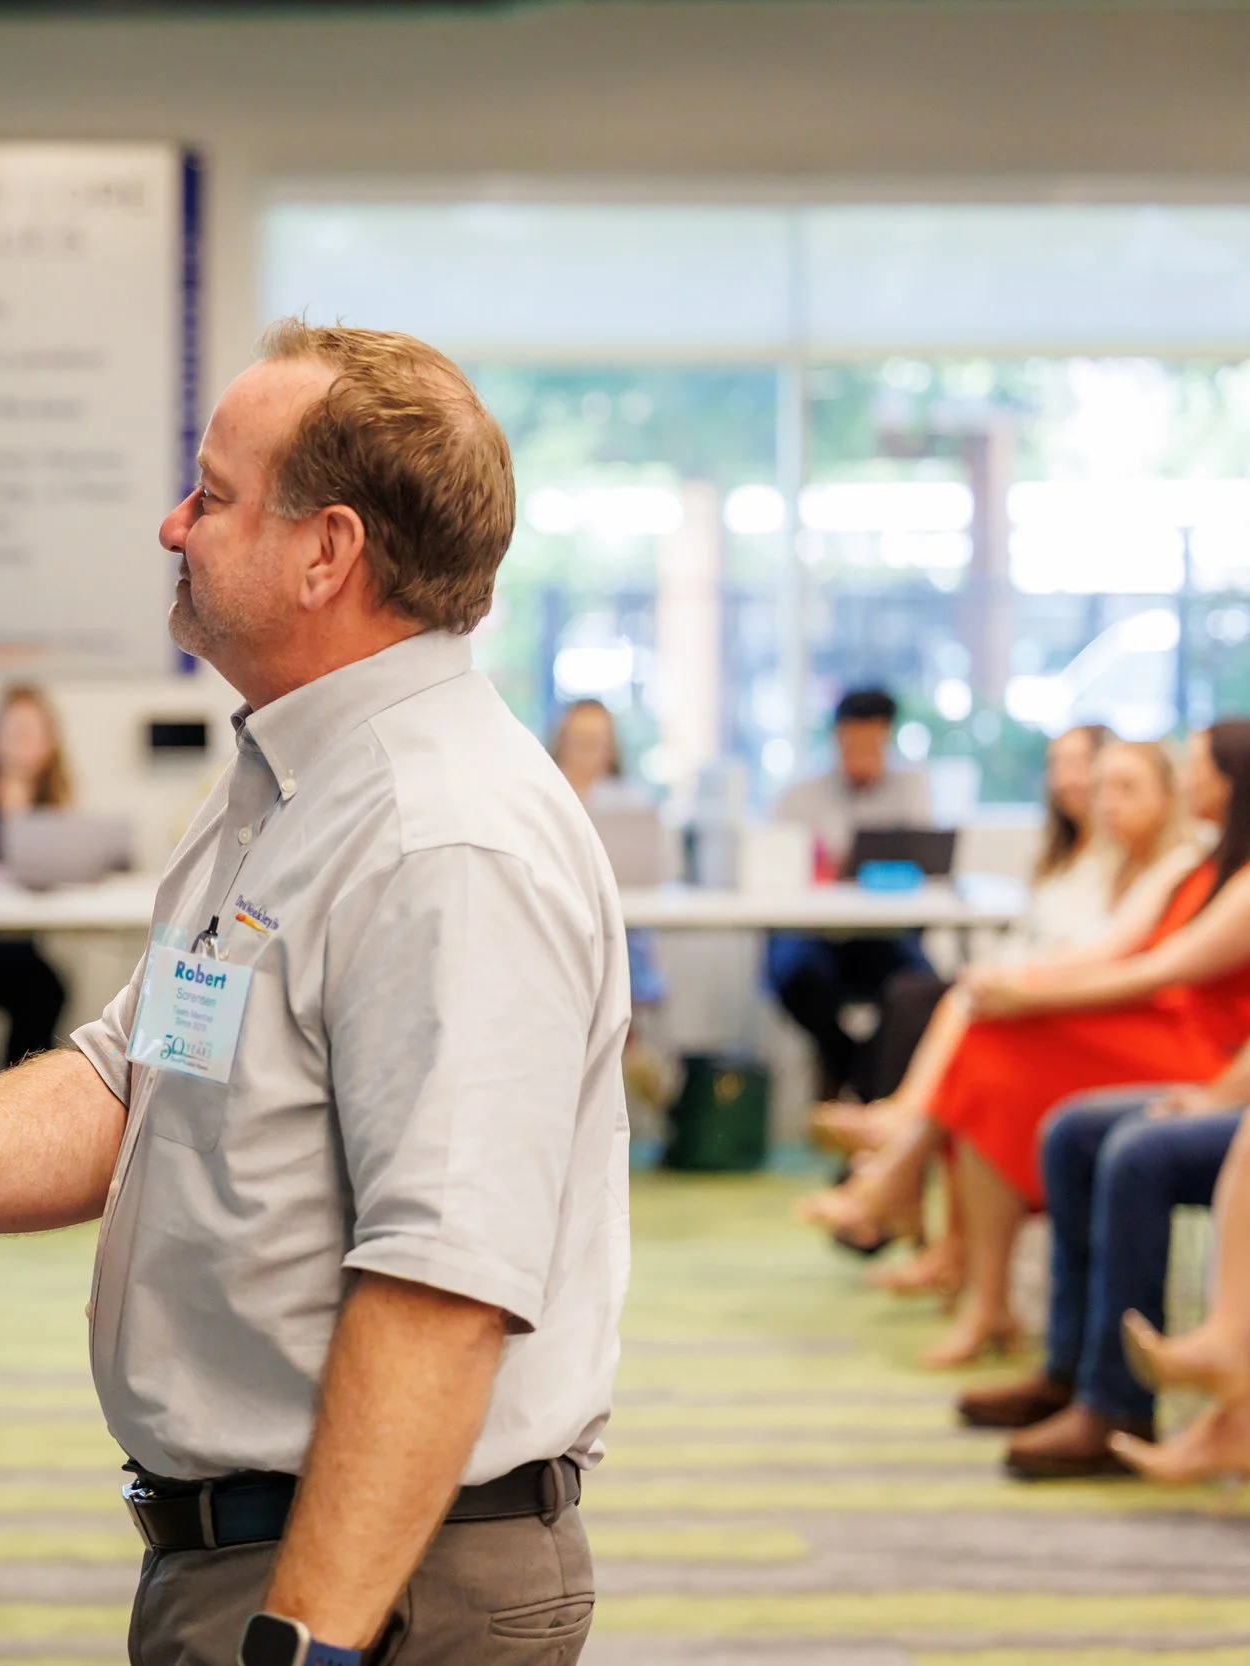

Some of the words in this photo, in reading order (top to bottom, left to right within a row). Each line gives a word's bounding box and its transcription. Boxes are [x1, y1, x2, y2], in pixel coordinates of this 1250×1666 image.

[175, 961, 226, 989] Robert
[176, 986, 217, 1007] Sorensen
[160, 1033, 185, 1060] 50
